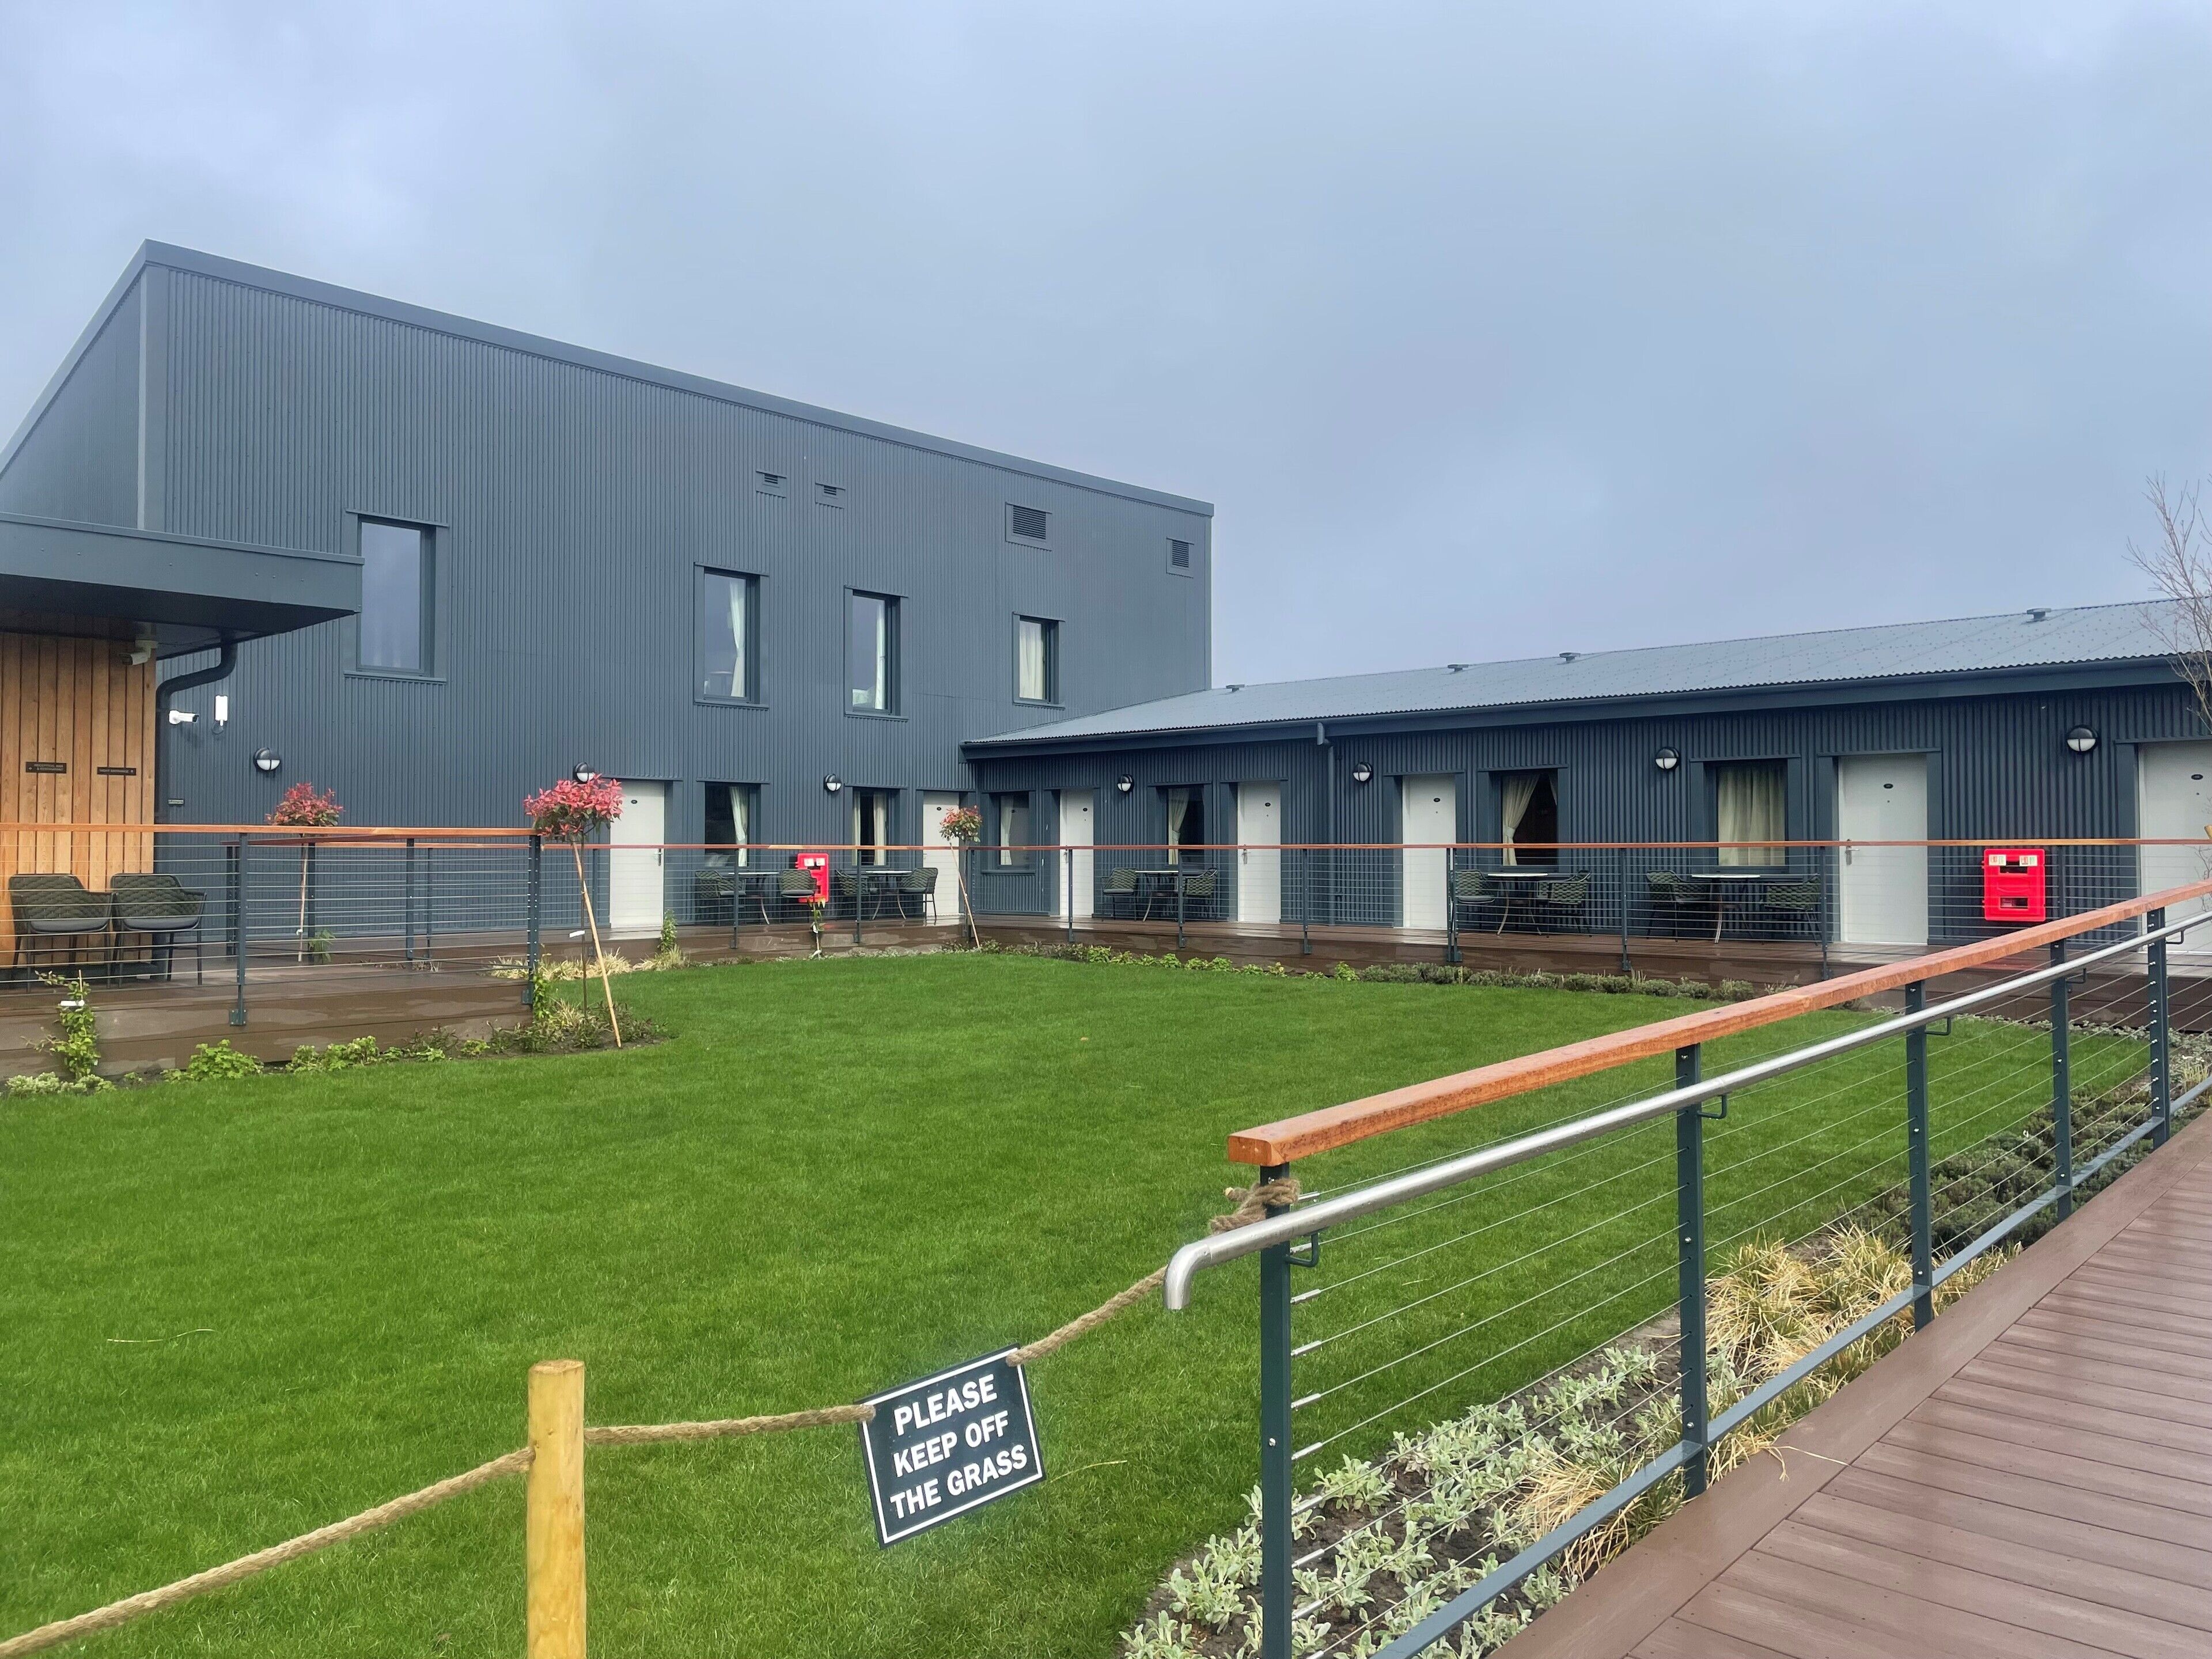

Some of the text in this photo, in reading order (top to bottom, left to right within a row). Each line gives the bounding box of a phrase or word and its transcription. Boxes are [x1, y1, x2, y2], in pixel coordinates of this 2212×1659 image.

[894, 1374, 997, 1435] PLEASE
[893, 1410, 1008, 1477] KEEP OFF
[890, 1445, 1027, 1518] THE GRASS
